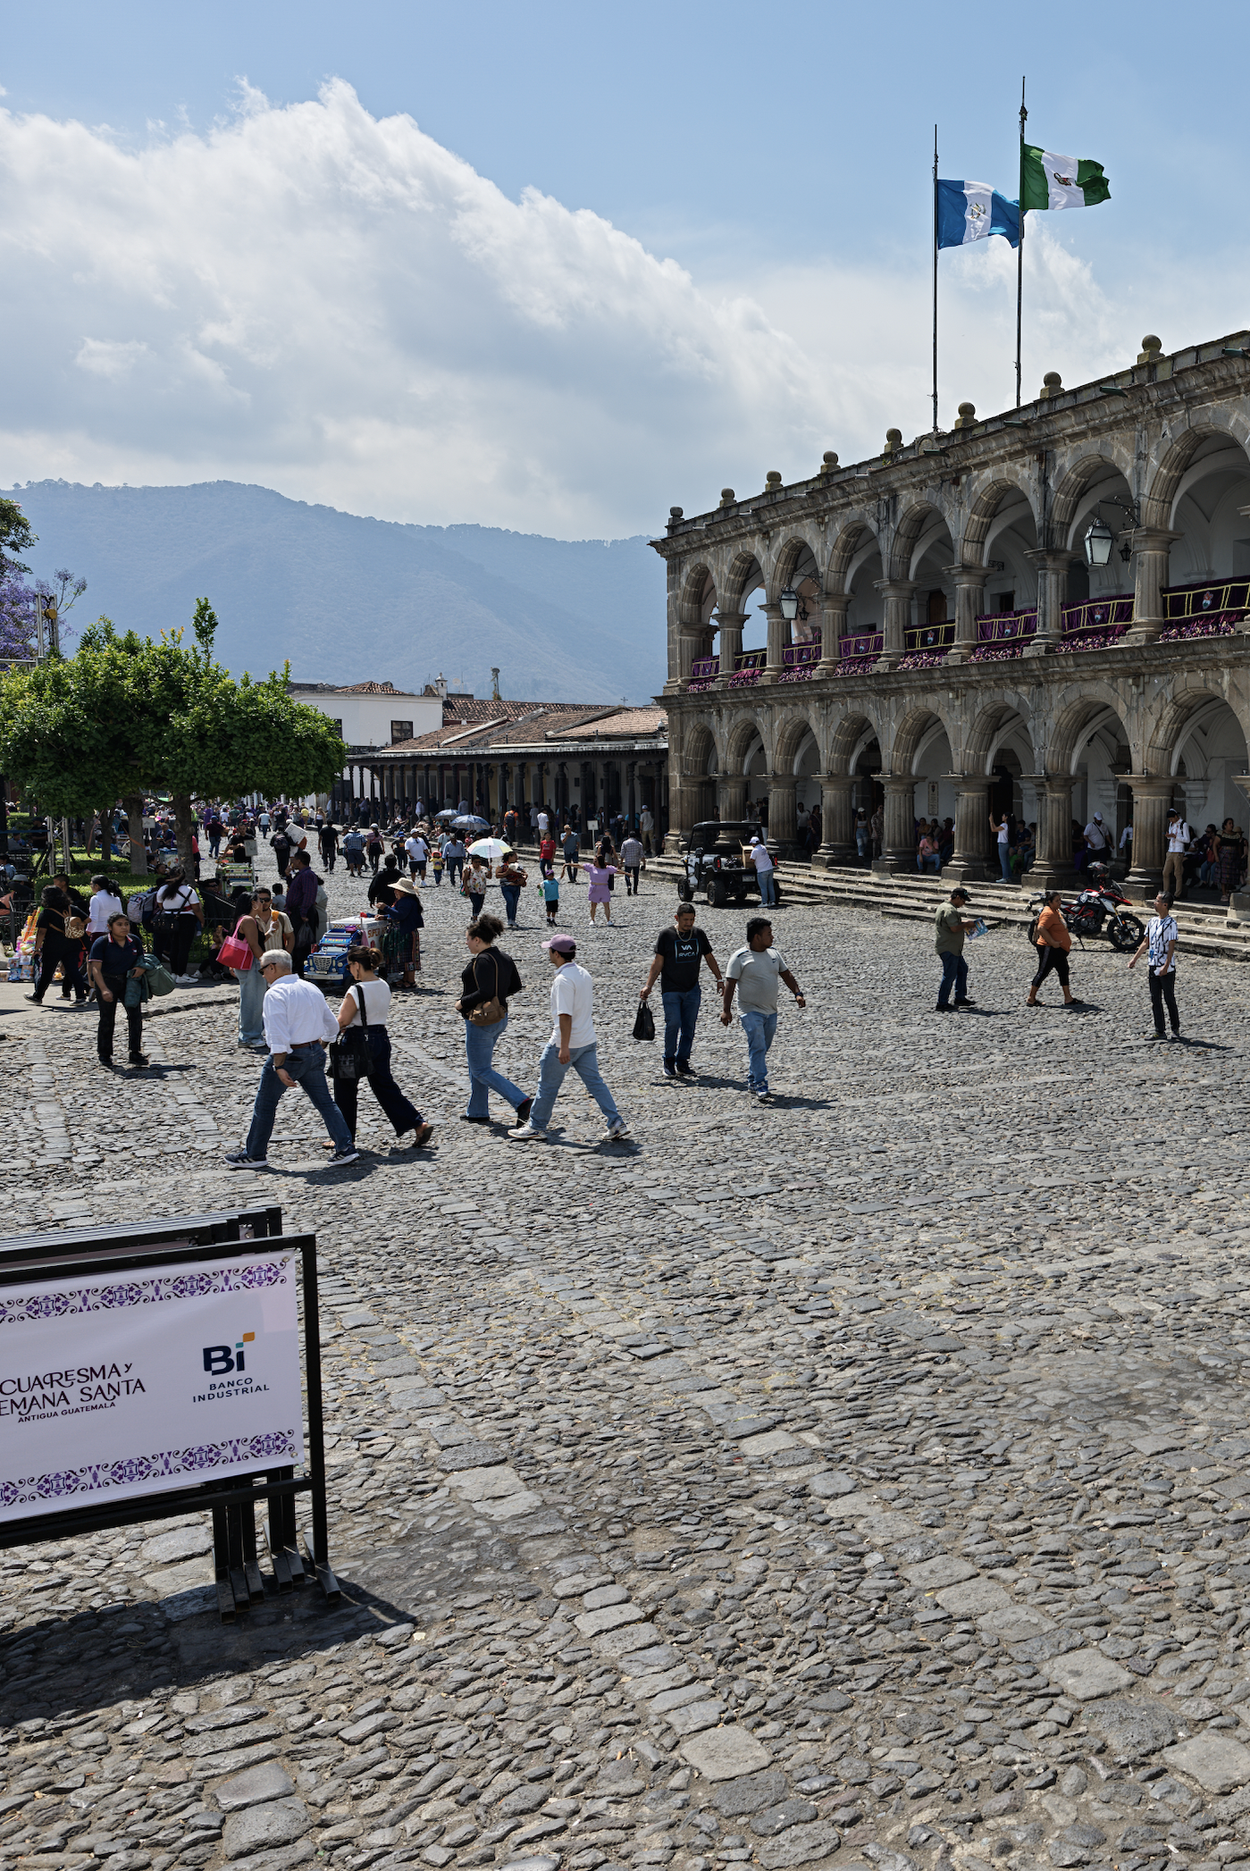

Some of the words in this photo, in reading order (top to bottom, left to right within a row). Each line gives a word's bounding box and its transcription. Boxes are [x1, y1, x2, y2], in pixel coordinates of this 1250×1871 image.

[203, 1342, 245, 1376] Bi
[0, 1363, 122, 1396] CUARESMA
[209, 1377, 253, 1391] BANCO
[0, 1390, 70, 1416] EMANA
[80, 1378, 146, 1402] SANTA
[193, 1384, 270, 1403] INDUSTRIAL
[18, 1411, 59, 1423] ANTIGUA
[61, 1401, 116, 1416] GUATEMALA
